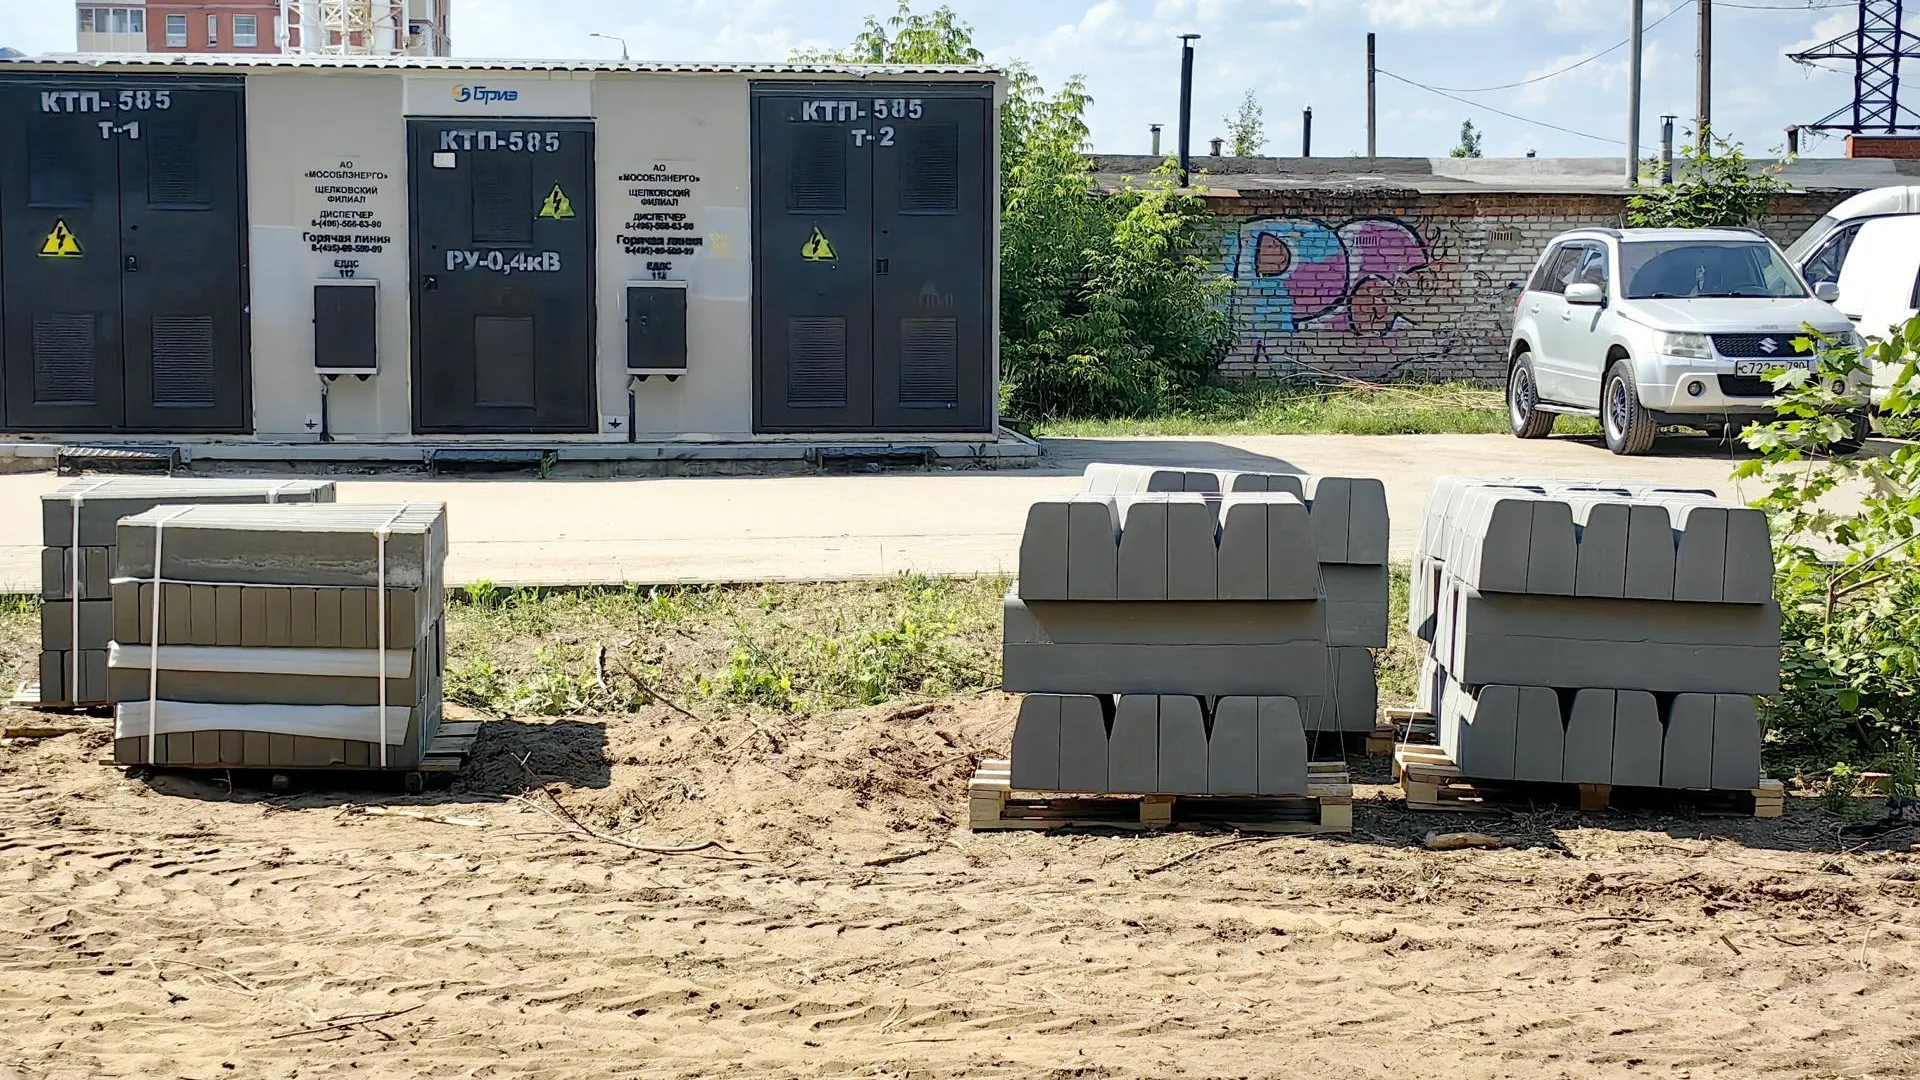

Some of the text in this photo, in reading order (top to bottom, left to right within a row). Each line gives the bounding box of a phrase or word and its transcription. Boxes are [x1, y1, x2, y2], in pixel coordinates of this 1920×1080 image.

[98, 121, 139, 139] Т-1
[440, 130, 560, 152] КТП-585
[339, 161, 353, 169] АО
[653, 164, 666, 172] АО
[314, 185, 378, 195] ЩЕЛКОВСКИЙ
[628, 188, 690, 198] ЩЕЛКОВСКИЙ
[327, 196, 366, 204] ФИЛИАЛ
[640, 199, 679, 207] ФИЛИАЛ
[320, 211, 374, 219] ДИСПЕТЧЕР
[633, 213, 686, 222] ДИСПЕТЧЕР
[303, 232, 391, 244] Горячая линия
[616, 234, 664, 247] Горячая
[446, 250, 561, 275] РУ-0,4кВ
